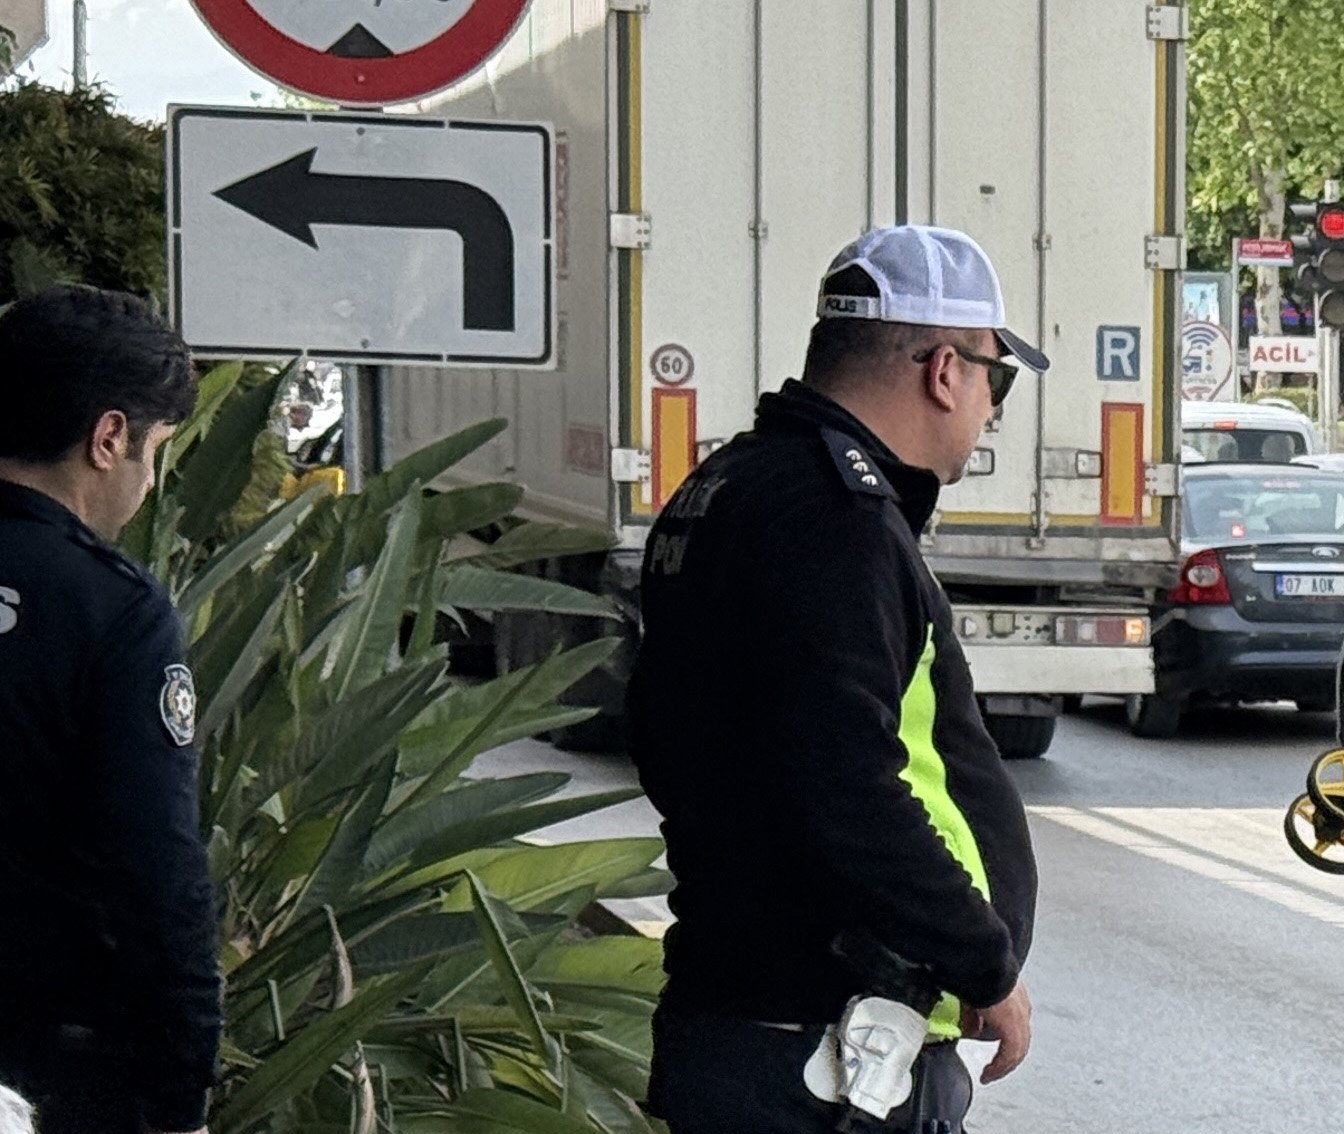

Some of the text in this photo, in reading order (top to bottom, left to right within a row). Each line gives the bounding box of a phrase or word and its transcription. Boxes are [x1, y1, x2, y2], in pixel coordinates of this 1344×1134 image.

[1103, 330, 1136, 377] R
[1253, 342, 1307, 363] ACİL
[660, 355, 684, 375] 60
[1285, 577, 1301, 593] 07
